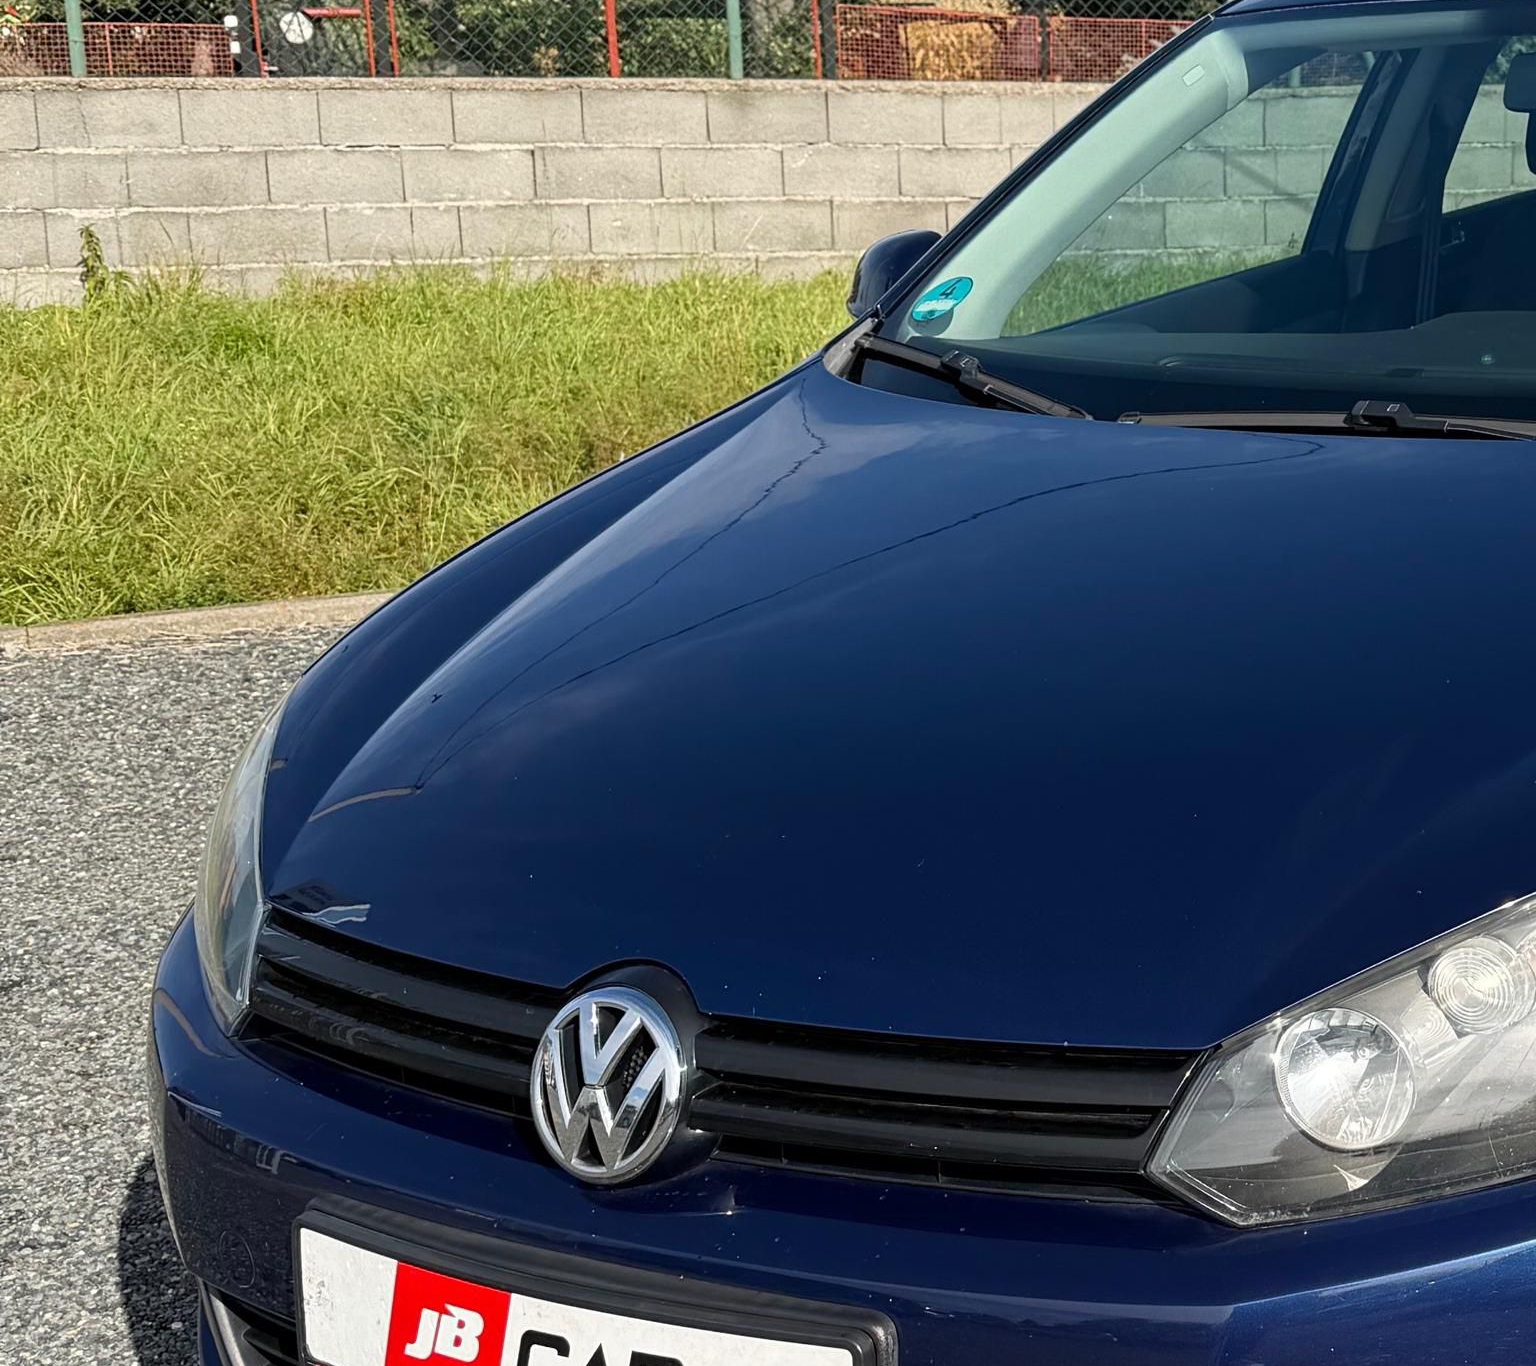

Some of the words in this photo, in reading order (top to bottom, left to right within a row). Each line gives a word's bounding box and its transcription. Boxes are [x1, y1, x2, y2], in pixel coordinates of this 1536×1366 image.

[939, 278, 963, 299] 4
[535, 989, 684, 1181] VW
[404, 1303, 485, 1363] JB
